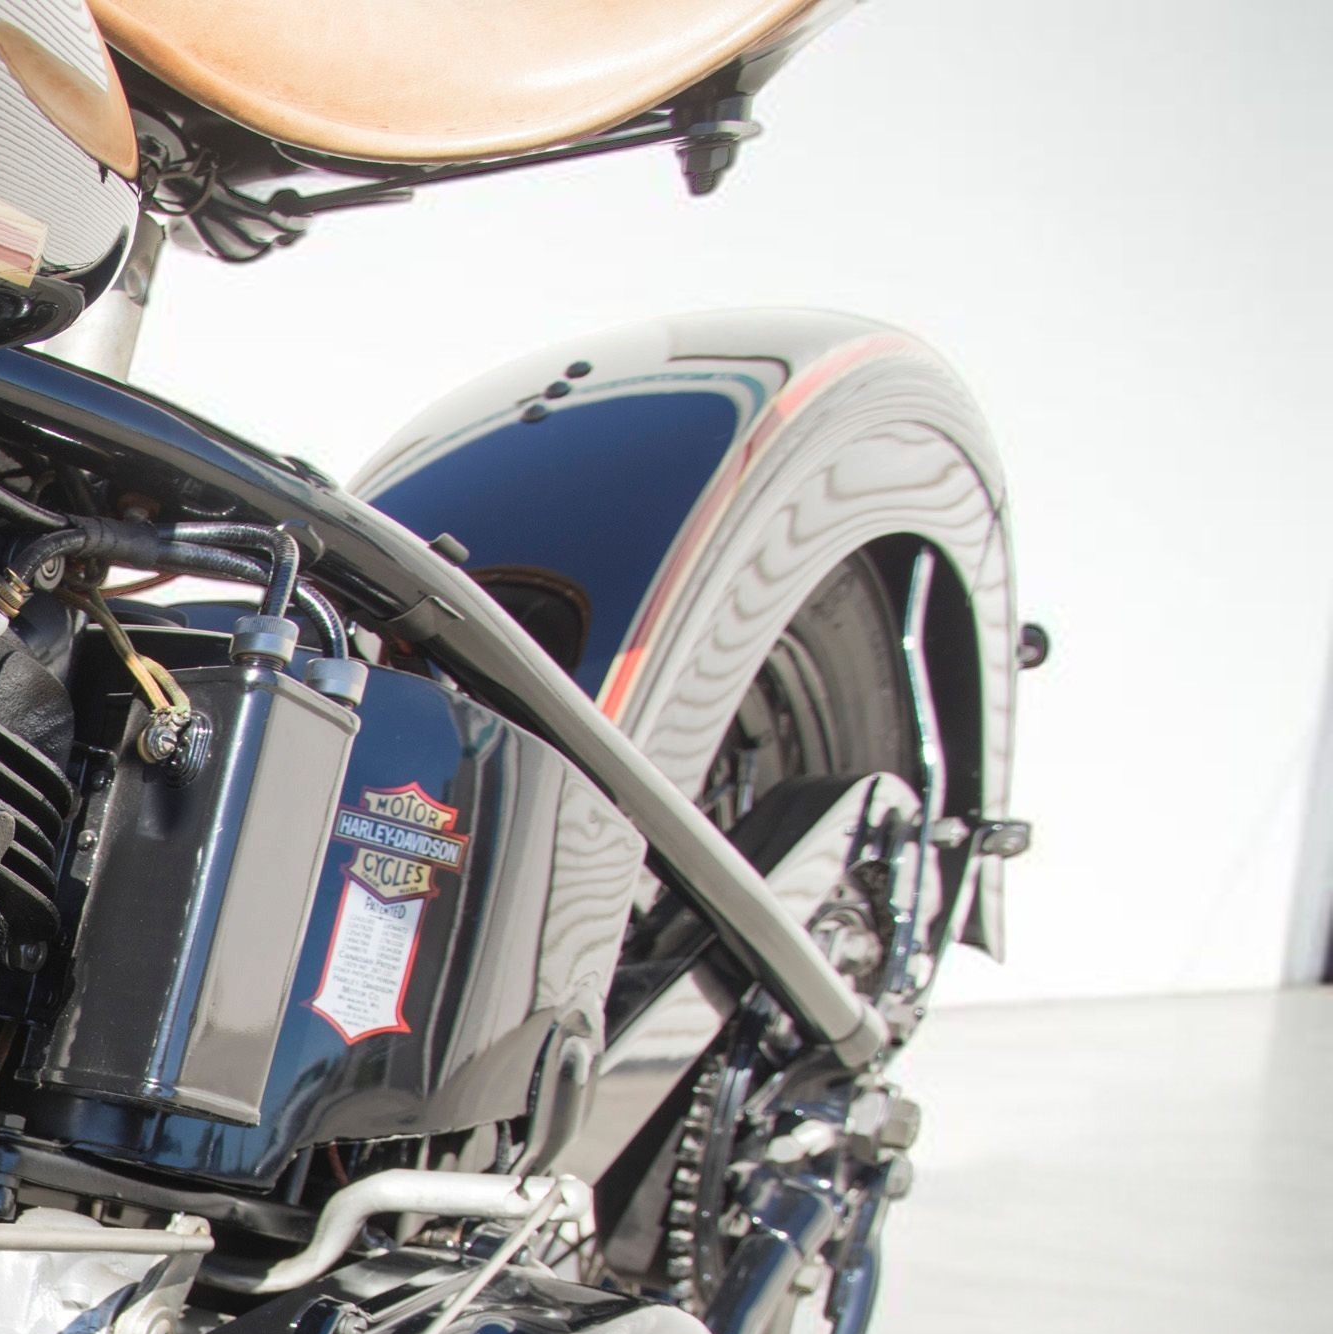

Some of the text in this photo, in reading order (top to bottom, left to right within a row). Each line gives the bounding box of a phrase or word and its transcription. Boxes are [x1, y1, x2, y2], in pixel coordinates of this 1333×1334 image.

[376, 794, 440, 827] MOTOR
[340, 814, 460, 863] HARLEY-DAVIDSON
[363, 852, 425, 886] CYCLES
